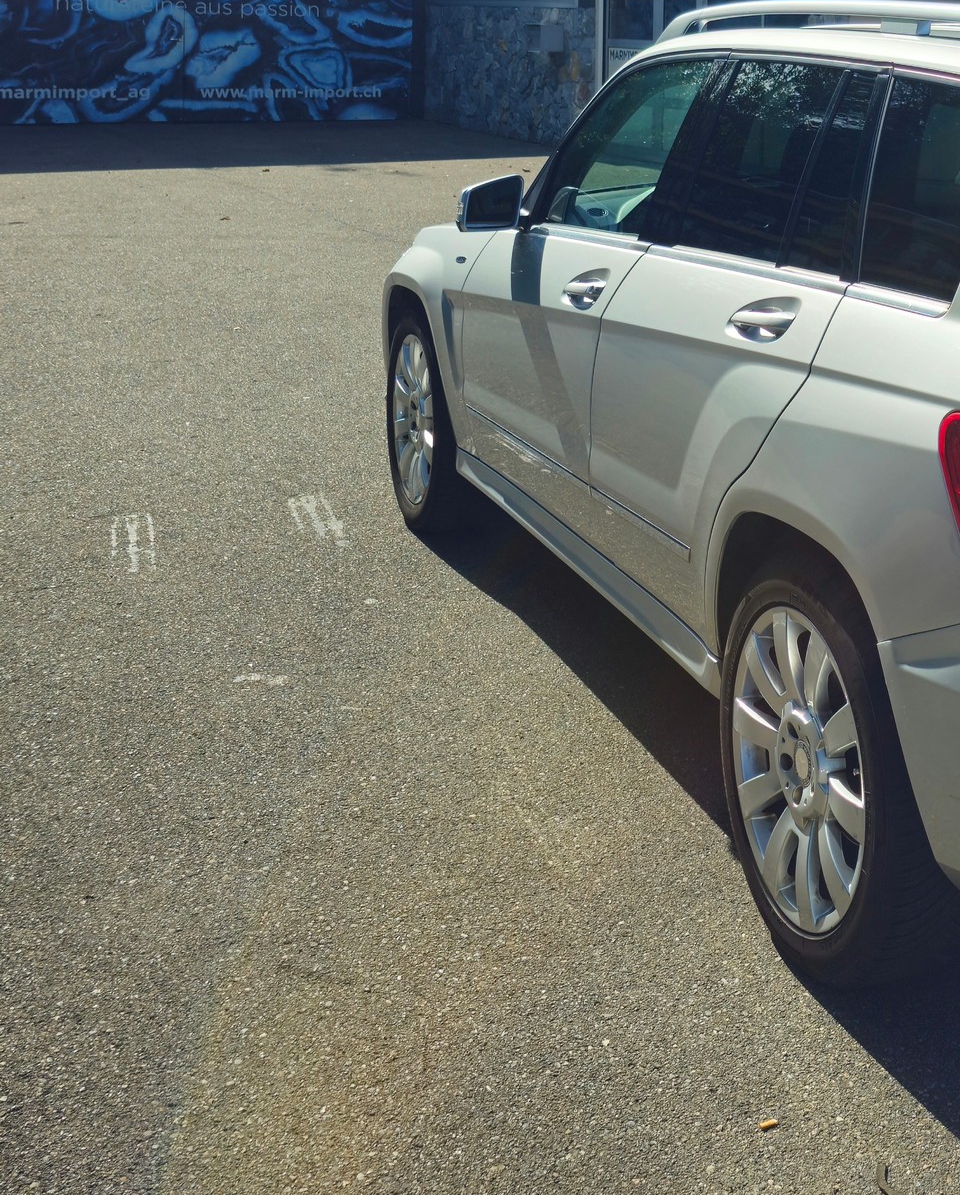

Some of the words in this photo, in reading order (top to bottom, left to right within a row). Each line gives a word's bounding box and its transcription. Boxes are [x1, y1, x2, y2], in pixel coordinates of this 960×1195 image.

[194, 1, 233, 15] aus
[241, 0, 321, 18] passion
[200, 85, 382, 101] www.marm-import.ch
